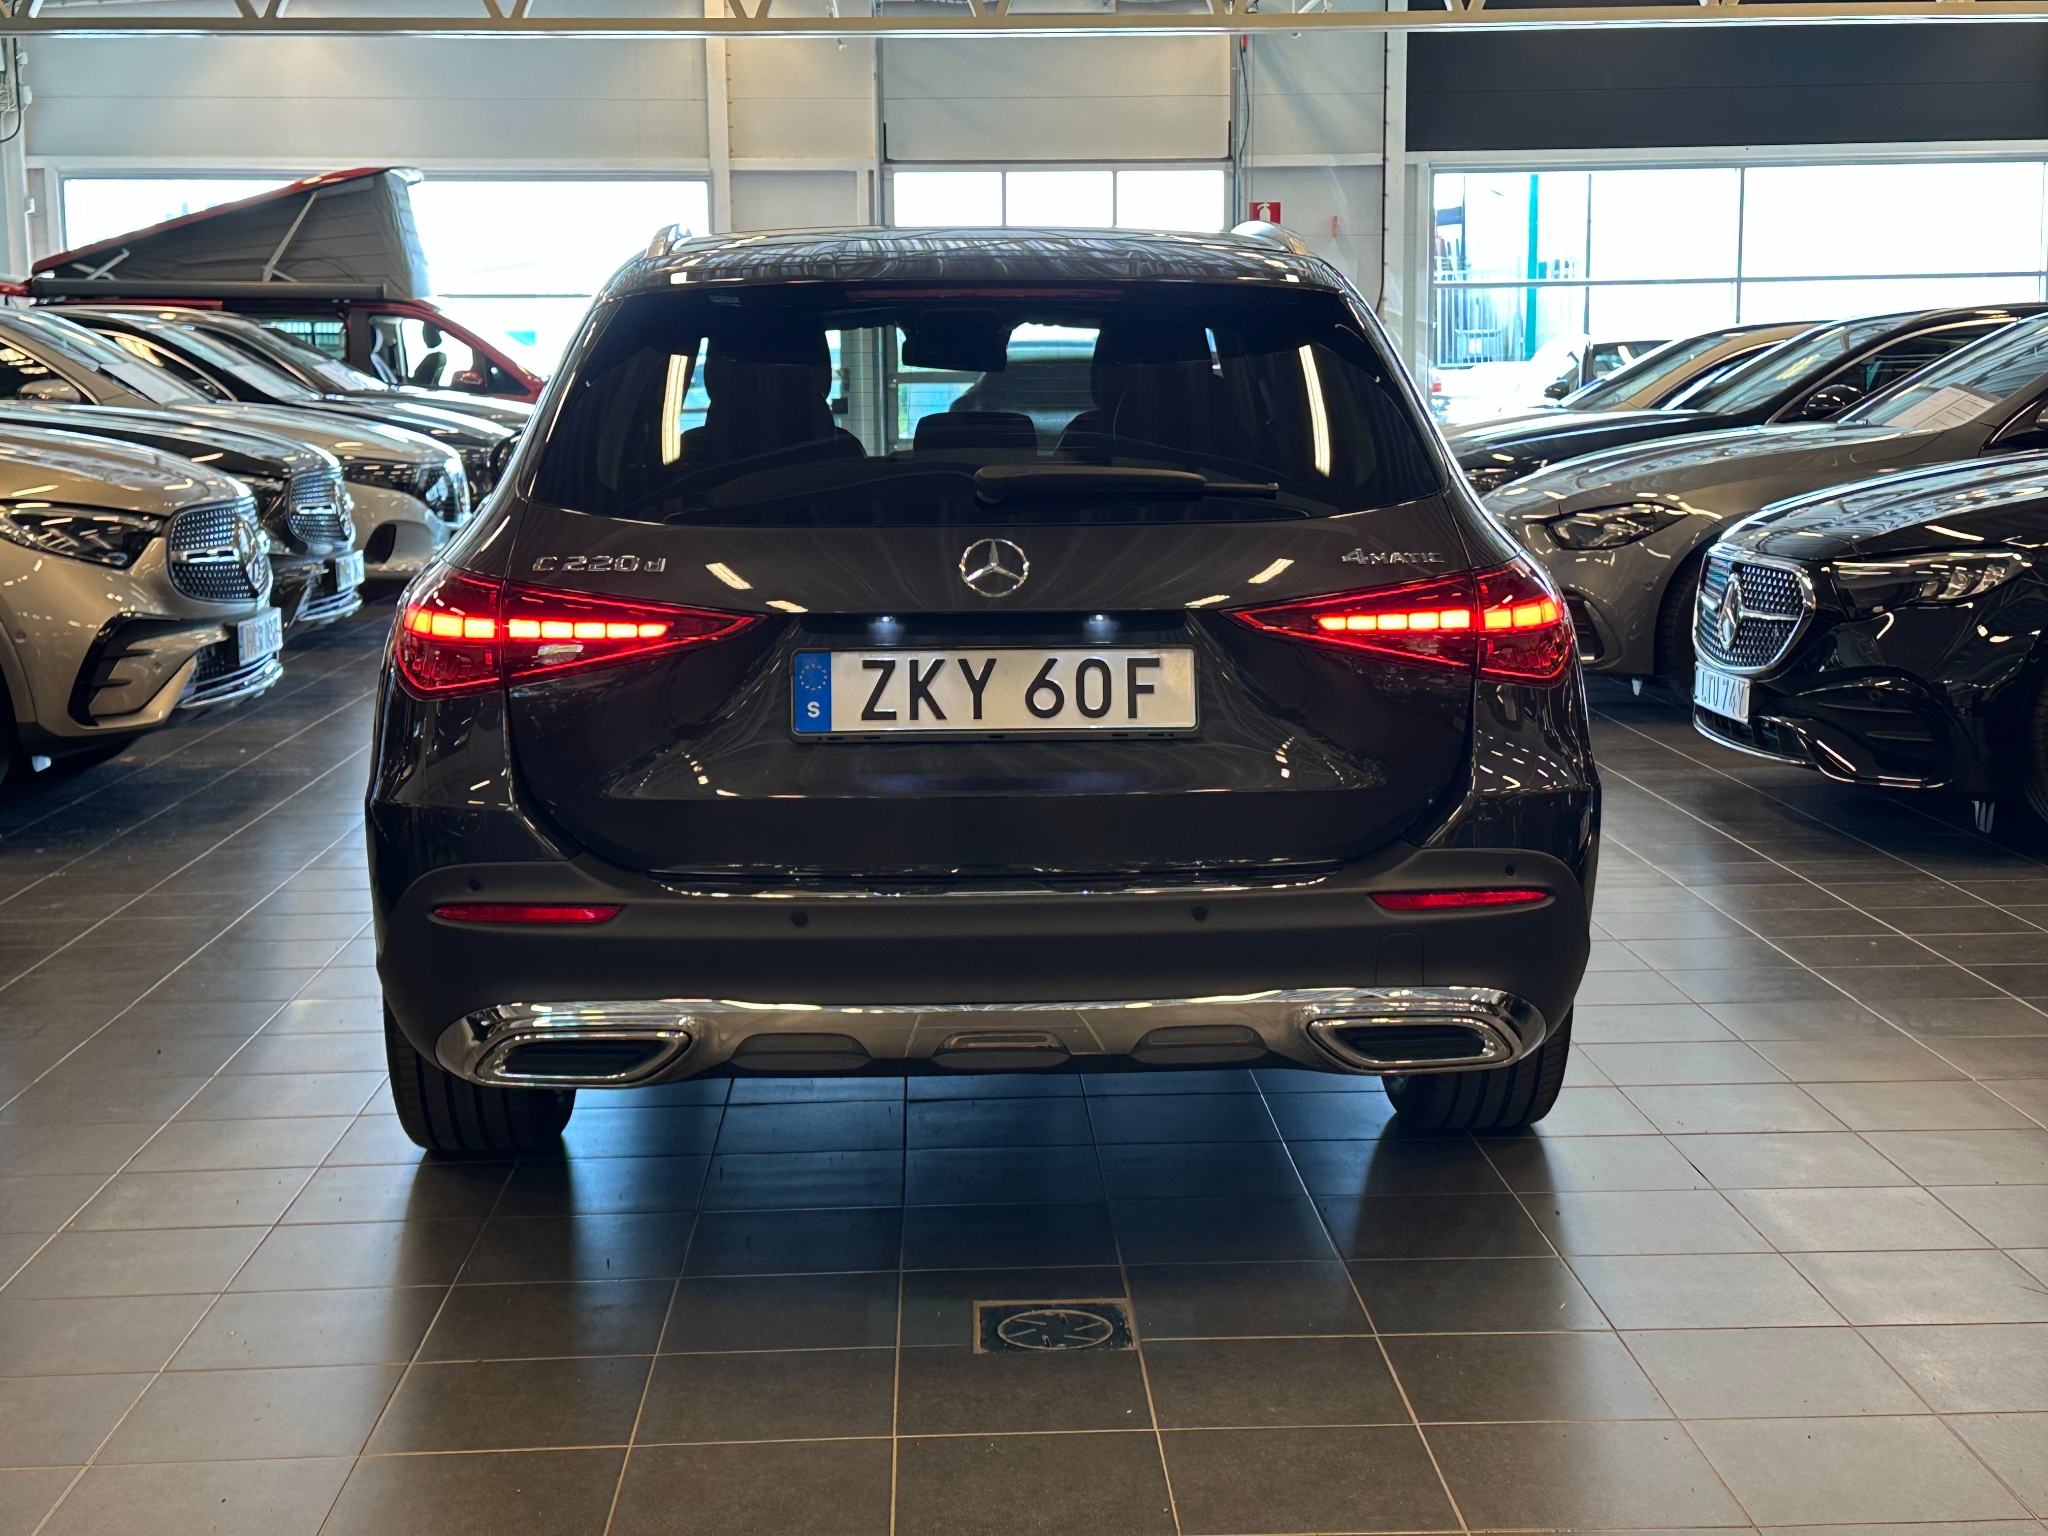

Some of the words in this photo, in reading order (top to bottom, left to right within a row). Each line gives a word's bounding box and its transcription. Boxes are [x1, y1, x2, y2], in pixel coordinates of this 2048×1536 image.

[532, 556, 557, 571] C
[561, 555, 640, 572] 220
[643, 557, 666, 572] d
[1341, 548, 1445, 565] 4MATIC
[861, 658, 997, 720] ZKY
[1025, 658, 1161, 719] 60F
[807, 701, 820, 718] S
